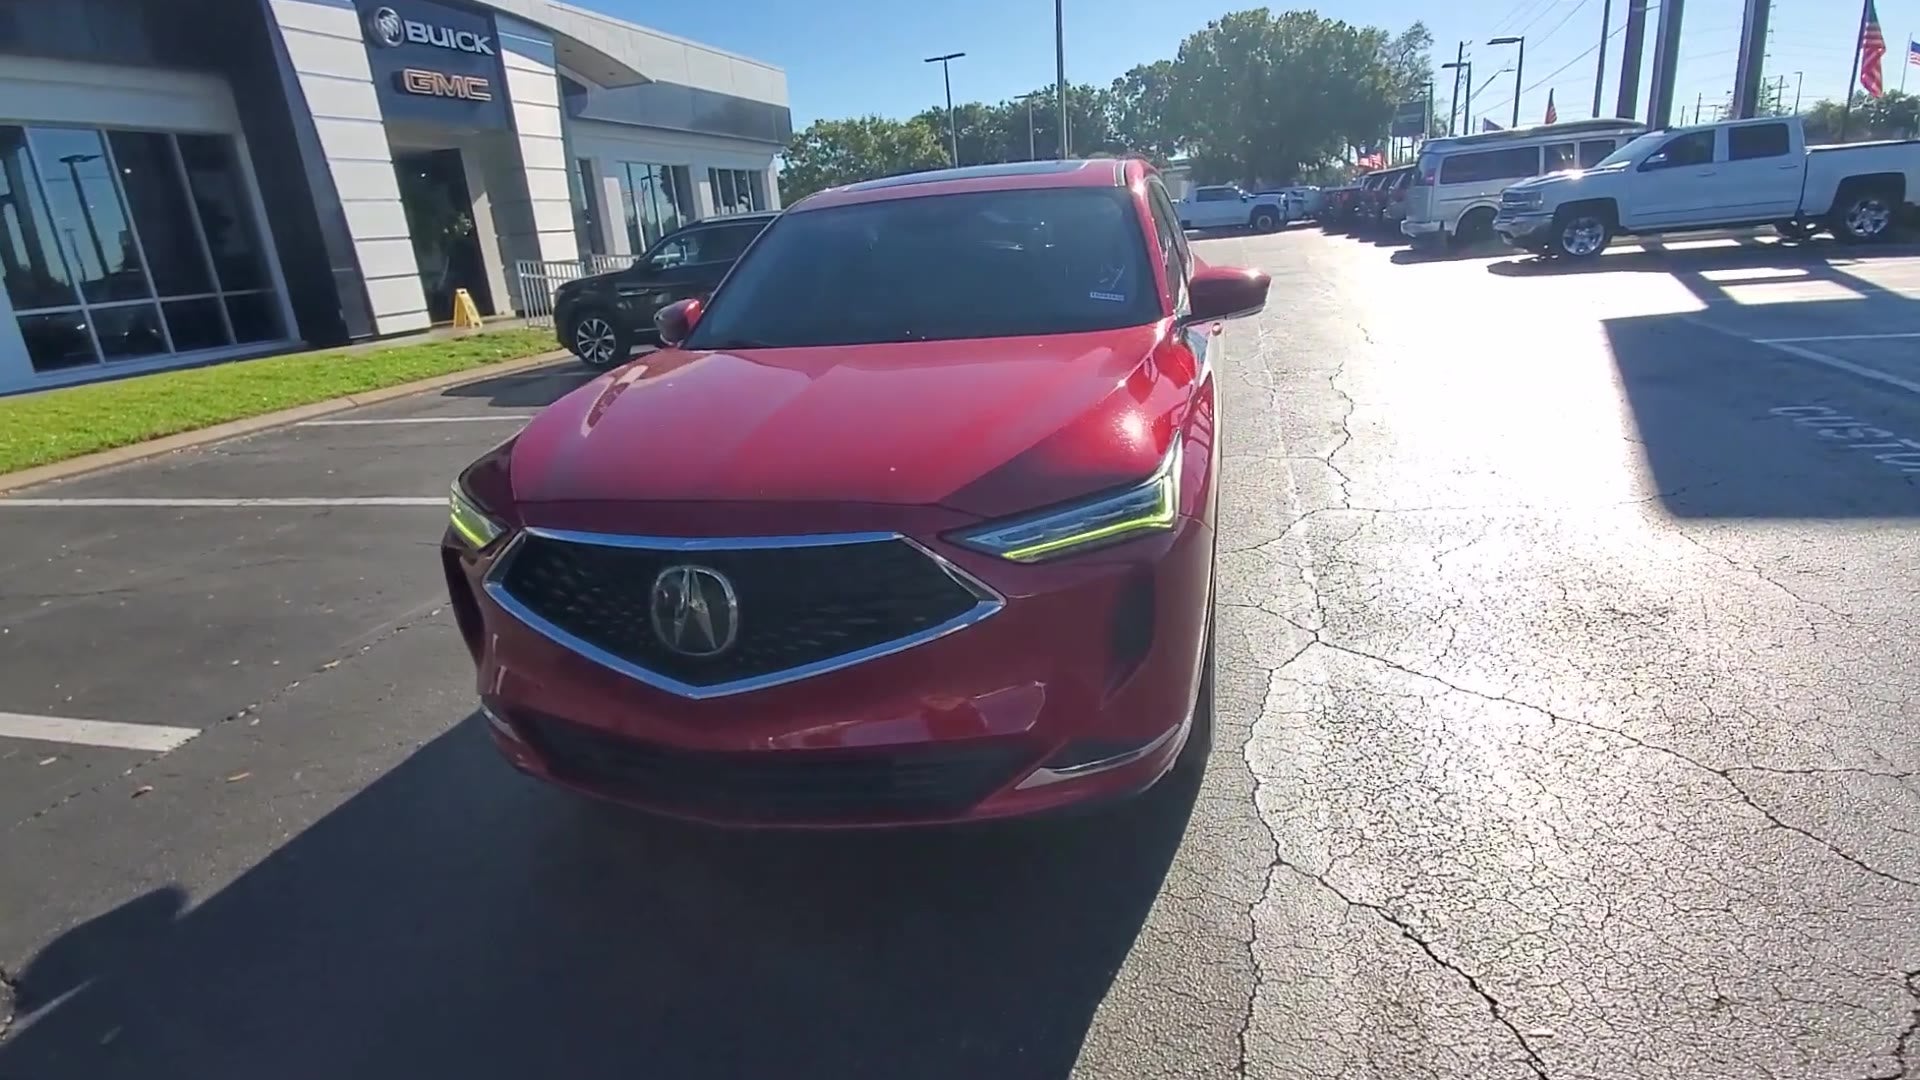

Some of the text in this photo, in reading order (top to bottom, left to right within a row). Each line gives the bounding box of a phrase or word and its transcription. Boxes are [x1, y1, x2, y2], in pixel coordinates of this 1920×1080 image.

[404, 20, 495, 55] BUICK
[403, 68, 492, 101] GMC
[1768, 406, 1920, 472] CUSTO
